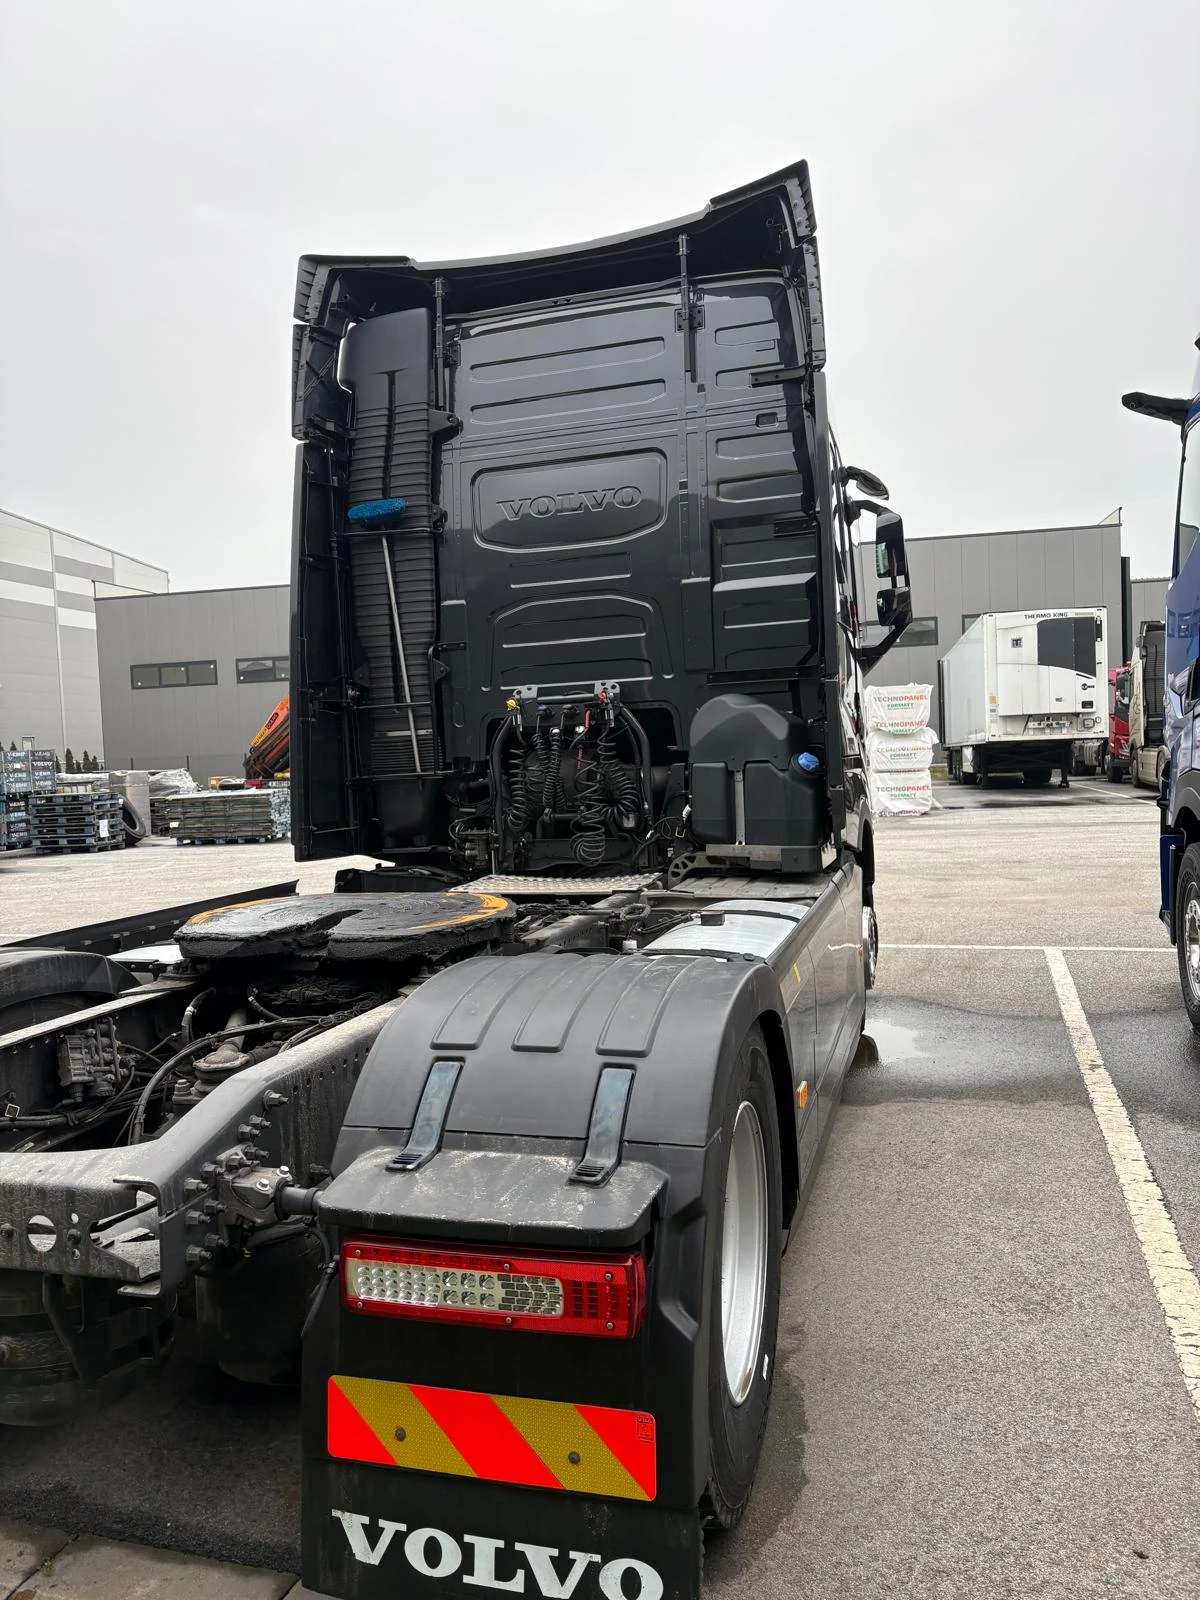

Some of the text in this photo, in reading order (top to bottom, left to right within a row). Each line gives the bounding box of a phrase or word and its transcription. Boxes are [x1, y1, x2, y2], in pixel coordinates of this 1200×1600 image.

[496, 485, 642, 521] VOLVO
[873, 694, 928, 703] TECHNOPANEL
[331, 1509, 664, 1600] VOLVO
